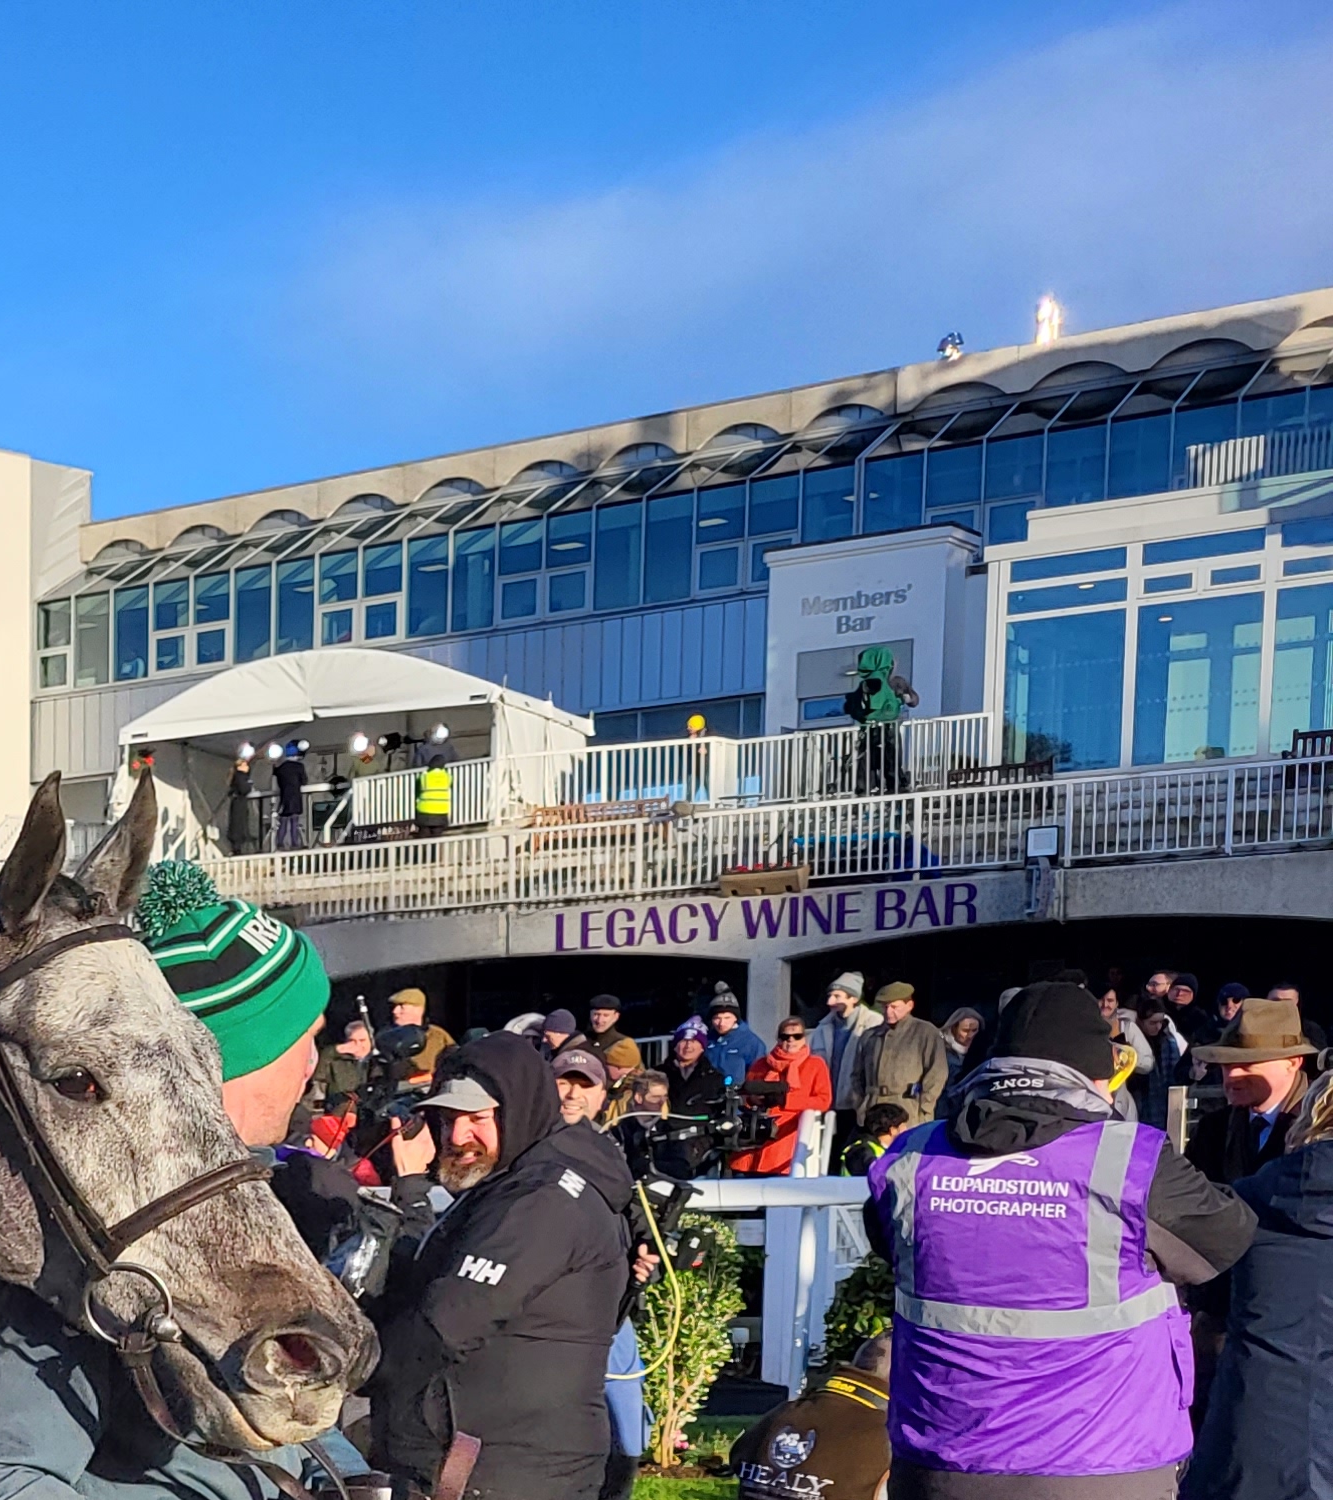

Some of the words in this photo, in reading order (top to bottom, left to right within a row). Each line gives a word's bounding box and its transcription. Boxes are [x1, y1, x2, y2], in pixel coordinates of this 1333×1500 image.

[801, 583, 912, 616] Members'
[836, 615, 876, 634] Bar
[237, 908, 282, 955] IRE
[554, 900, 731, 952] LEGACY
[742, 890, 862, 940] WINE
[875, 882, 979, 932] BAR
[990, 1078, 1045, 1092] SONY
[932, 1175, 1070, 1198] LEOPARDSTOWN
[930, 1197, 1067, 1219] PHOTOGRAPHER
[457, 1254, 507, 1286] HH
[739, 1461, 835, 1495] HEALY
